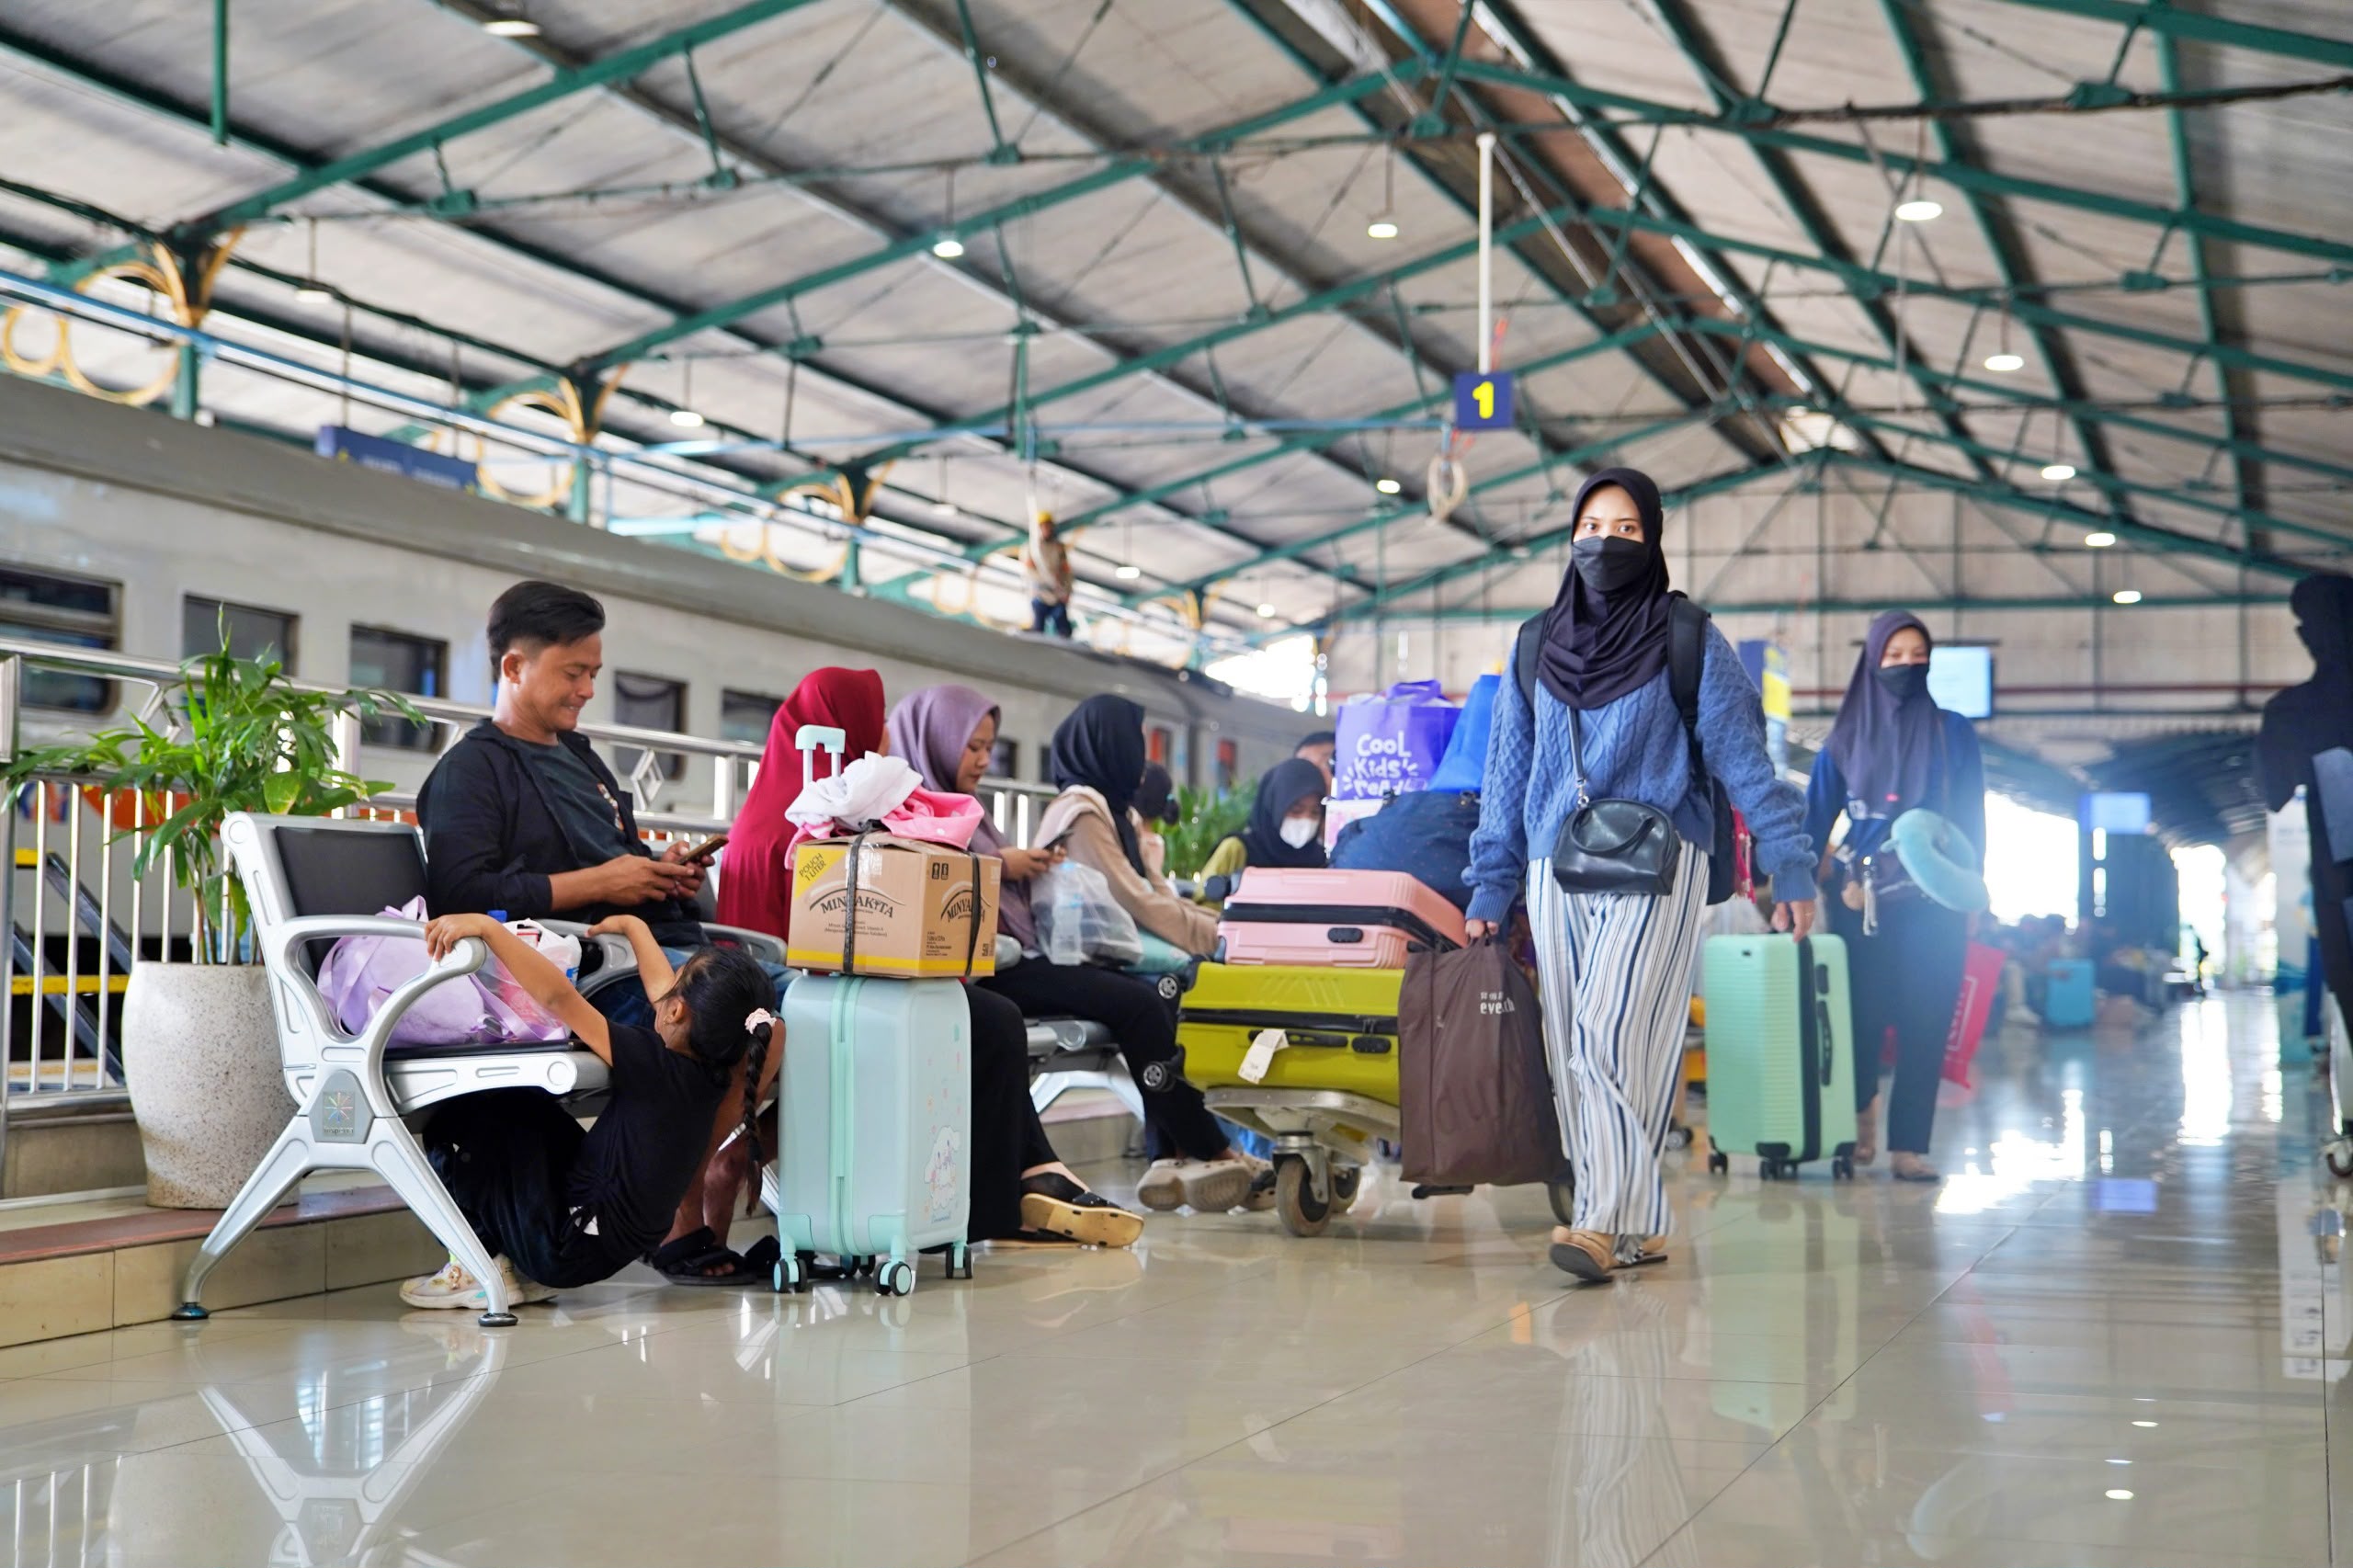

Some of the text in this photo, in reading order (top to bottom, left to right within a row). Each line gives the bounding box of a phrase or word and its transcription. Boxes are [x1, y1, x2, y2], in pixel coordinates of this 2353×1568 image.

[1472, 381, 1495, 419] 1
[799, 853, 823, 878] POUCH
[809, 860, 826, 878] LITER
[821, 896, 893, 918] MINAKITA
